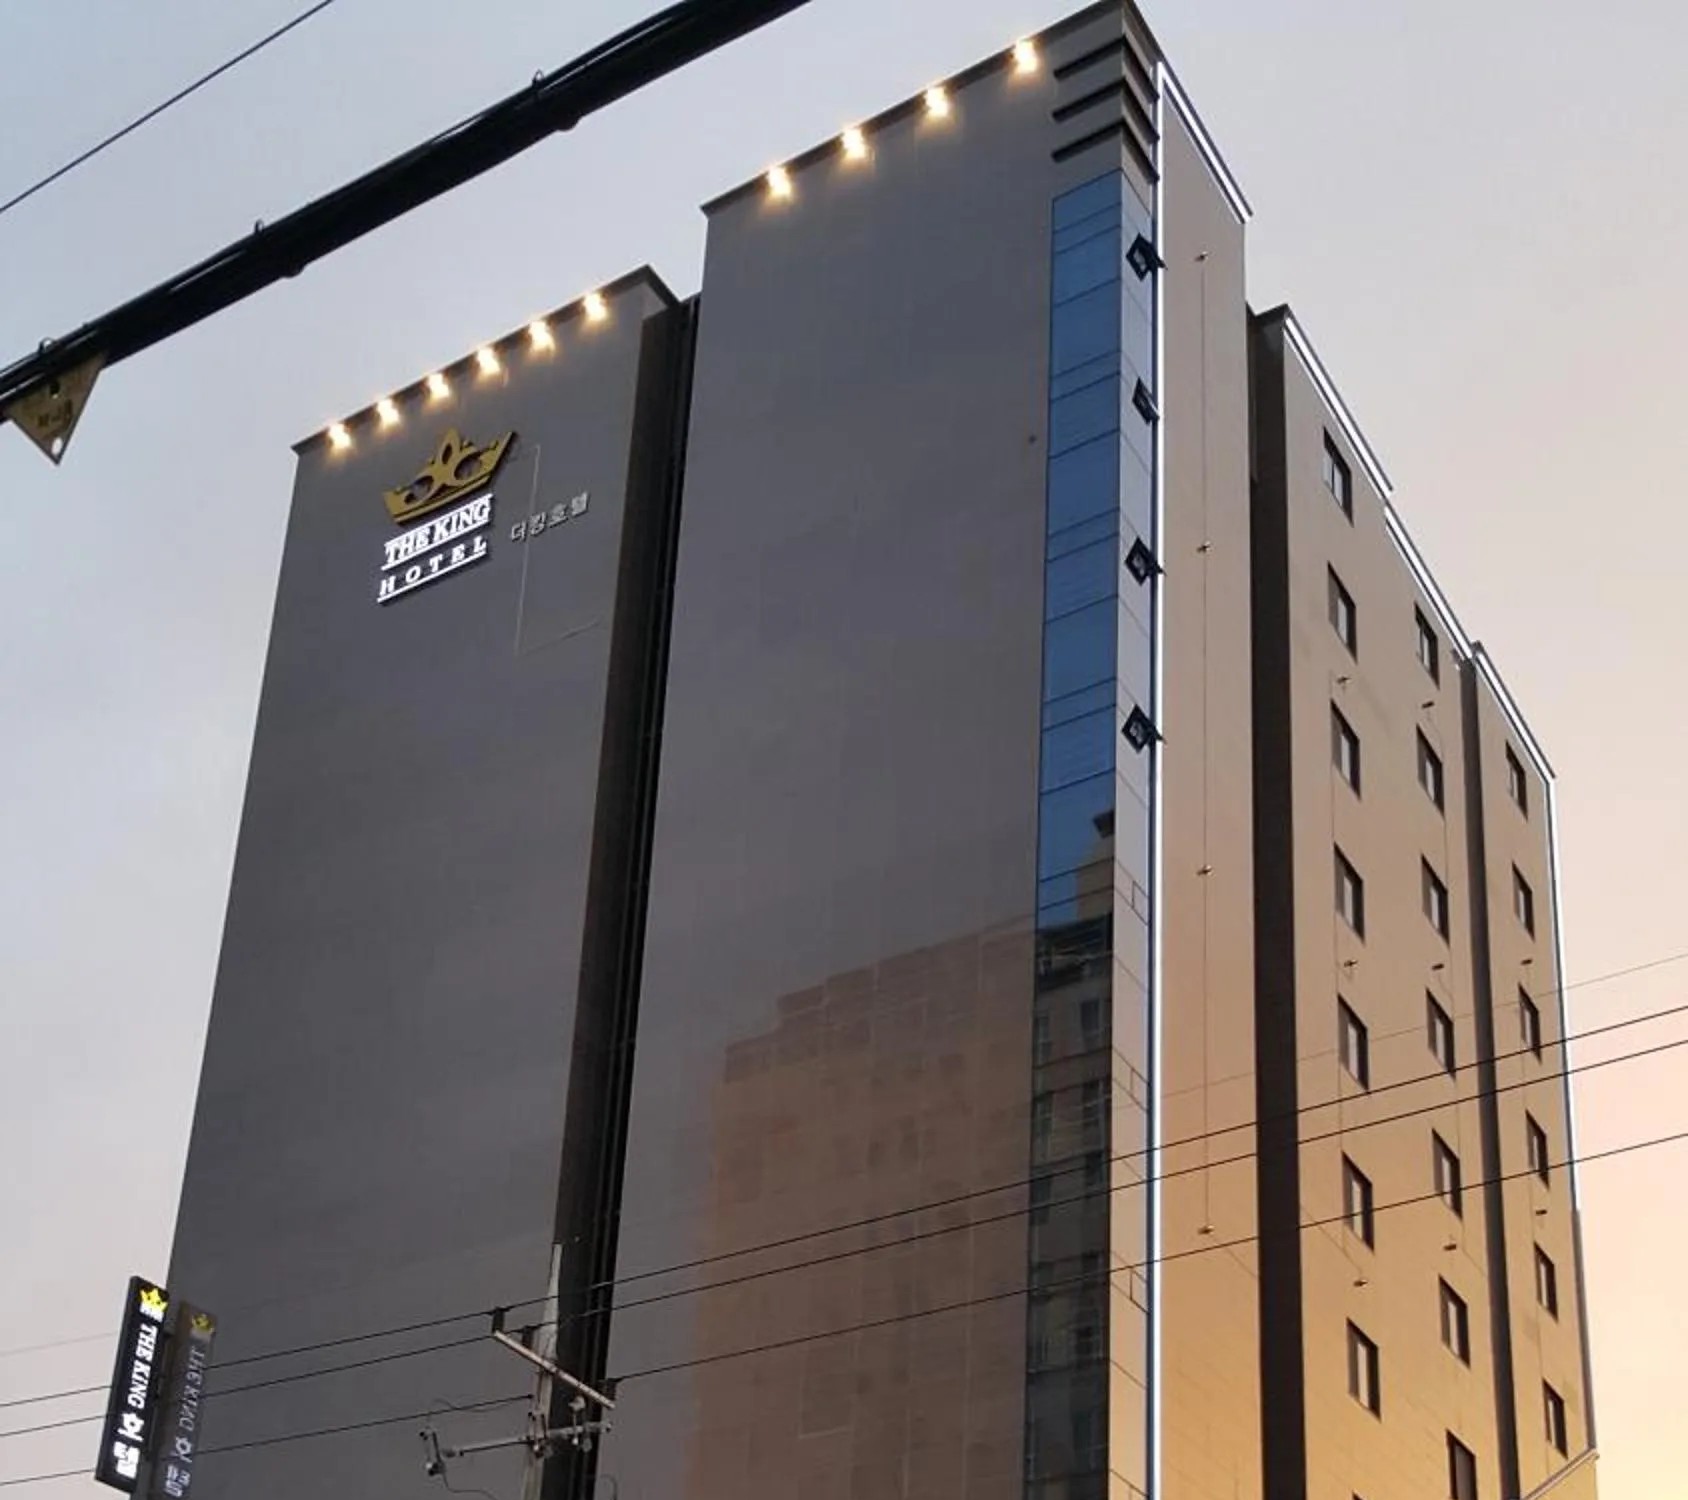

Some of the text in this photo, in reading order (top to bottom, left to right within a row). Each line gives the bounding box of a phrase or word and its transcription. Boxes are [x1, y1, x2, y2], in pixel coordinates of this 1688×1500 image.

[432, 495, 492, 548] KING
[379, 535, 487, 597] HOTEL
[113, 1323, 158, 1480] THE KING 호텔
